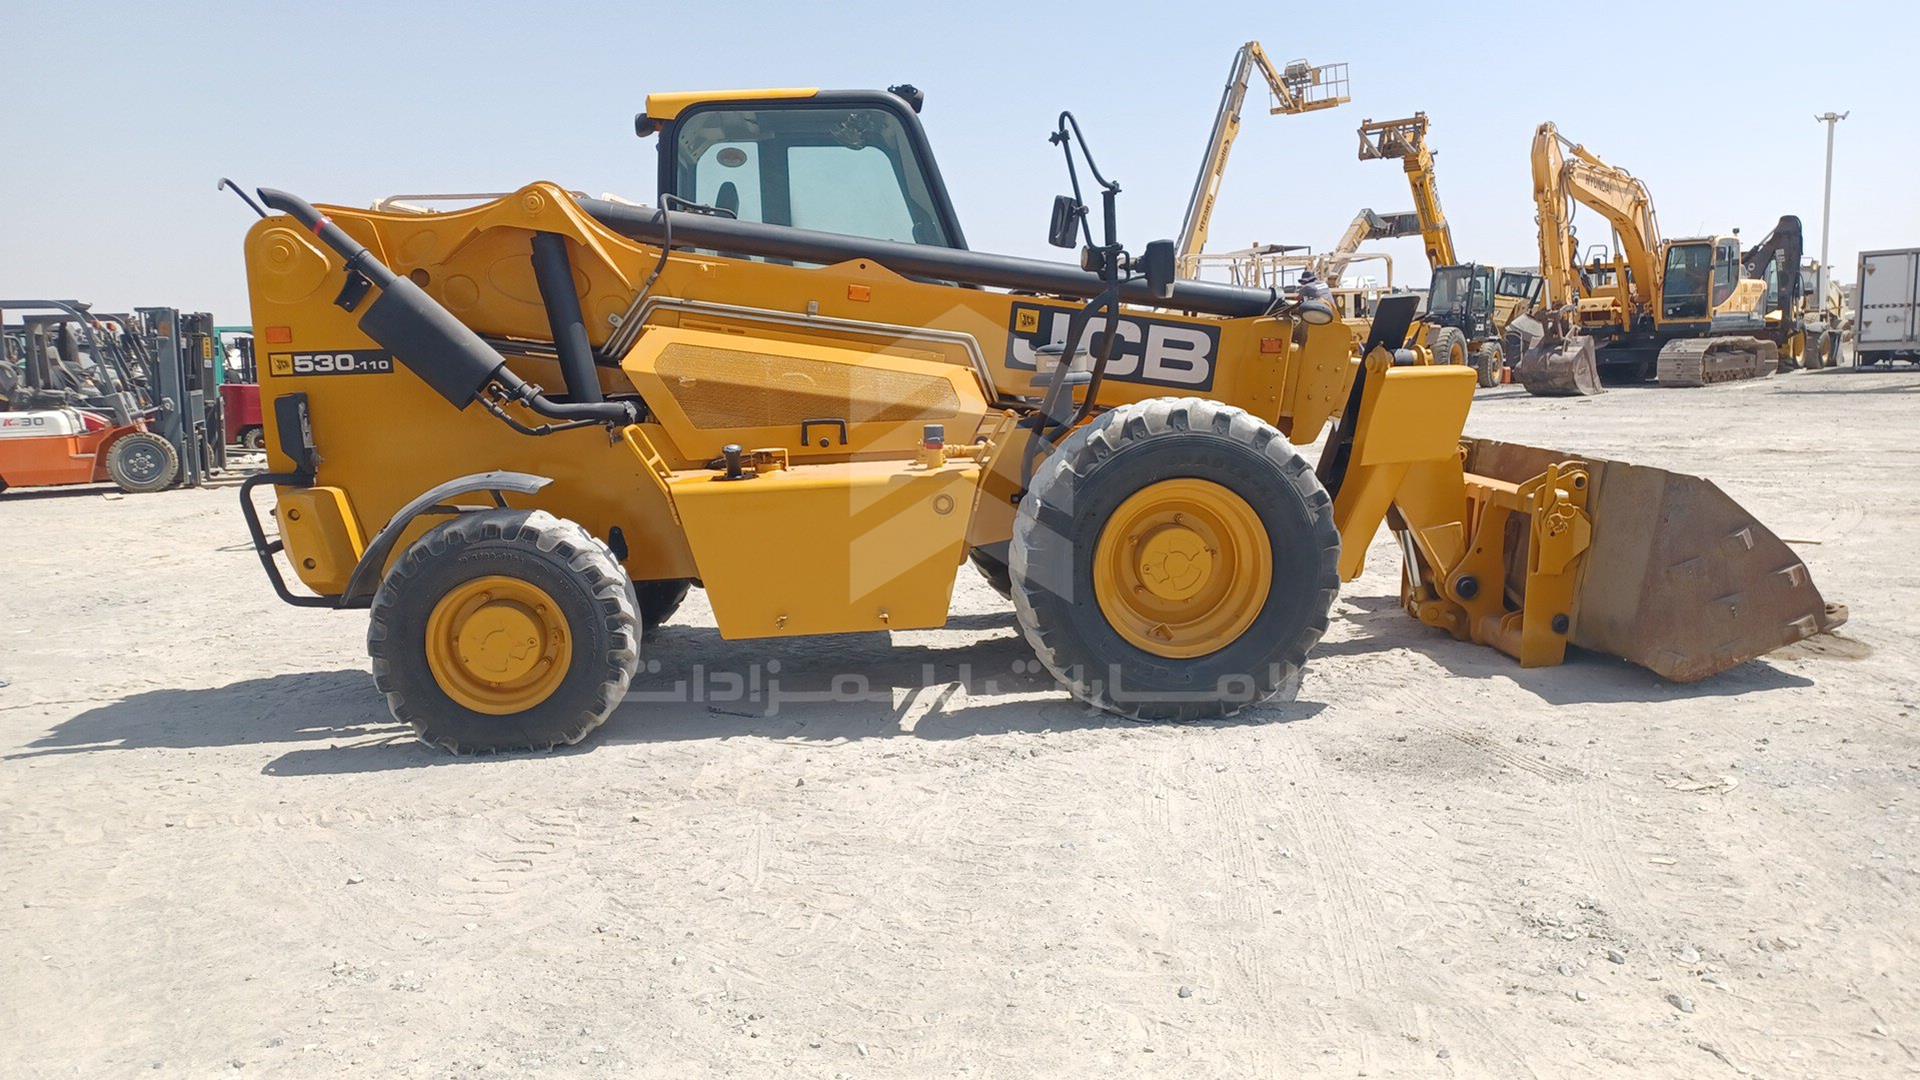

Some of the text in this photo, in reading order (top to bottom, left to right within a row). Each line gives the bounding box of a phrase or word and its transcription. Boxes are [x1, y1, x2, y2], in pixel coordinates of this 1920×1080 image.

[1585, 174, 1611, 195] HYUNDAI
[1013, 312, 1212, 384] JCB
[294, 354, 389, 372] 530-110
[20, 417, 45, 426] 30
